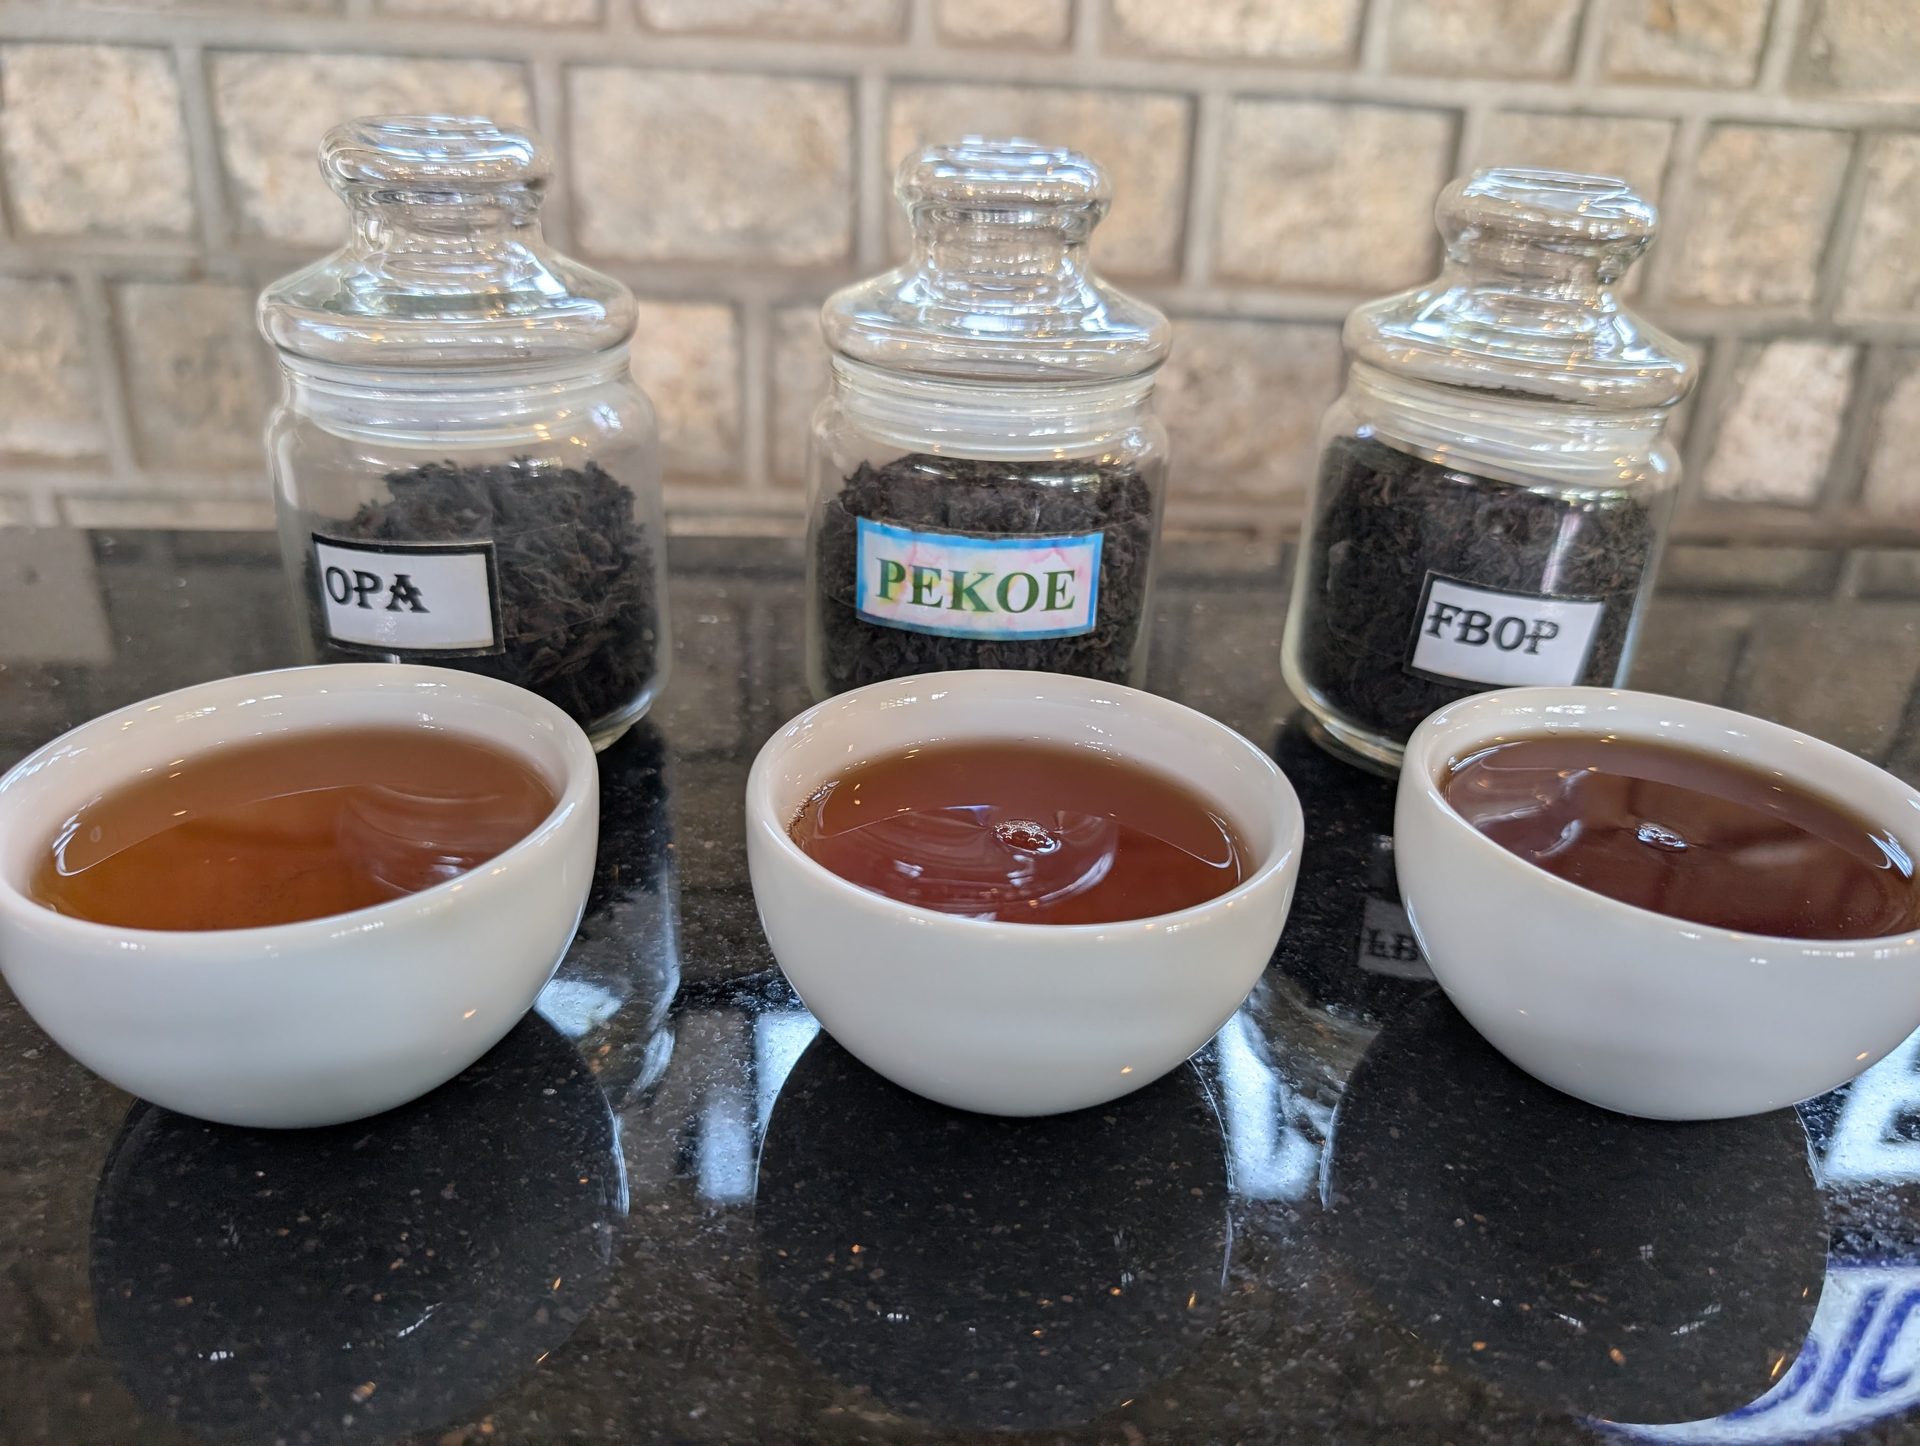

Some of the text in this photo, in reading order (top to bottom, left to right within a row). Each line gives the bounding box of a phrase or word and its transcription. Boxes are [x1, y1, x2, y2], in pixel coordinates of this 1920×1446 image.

[325, 566, 431, 613] OPA
[875, 557, 1076, 614] PEKOE
[1425, 601, 1559, 655] FBOP
